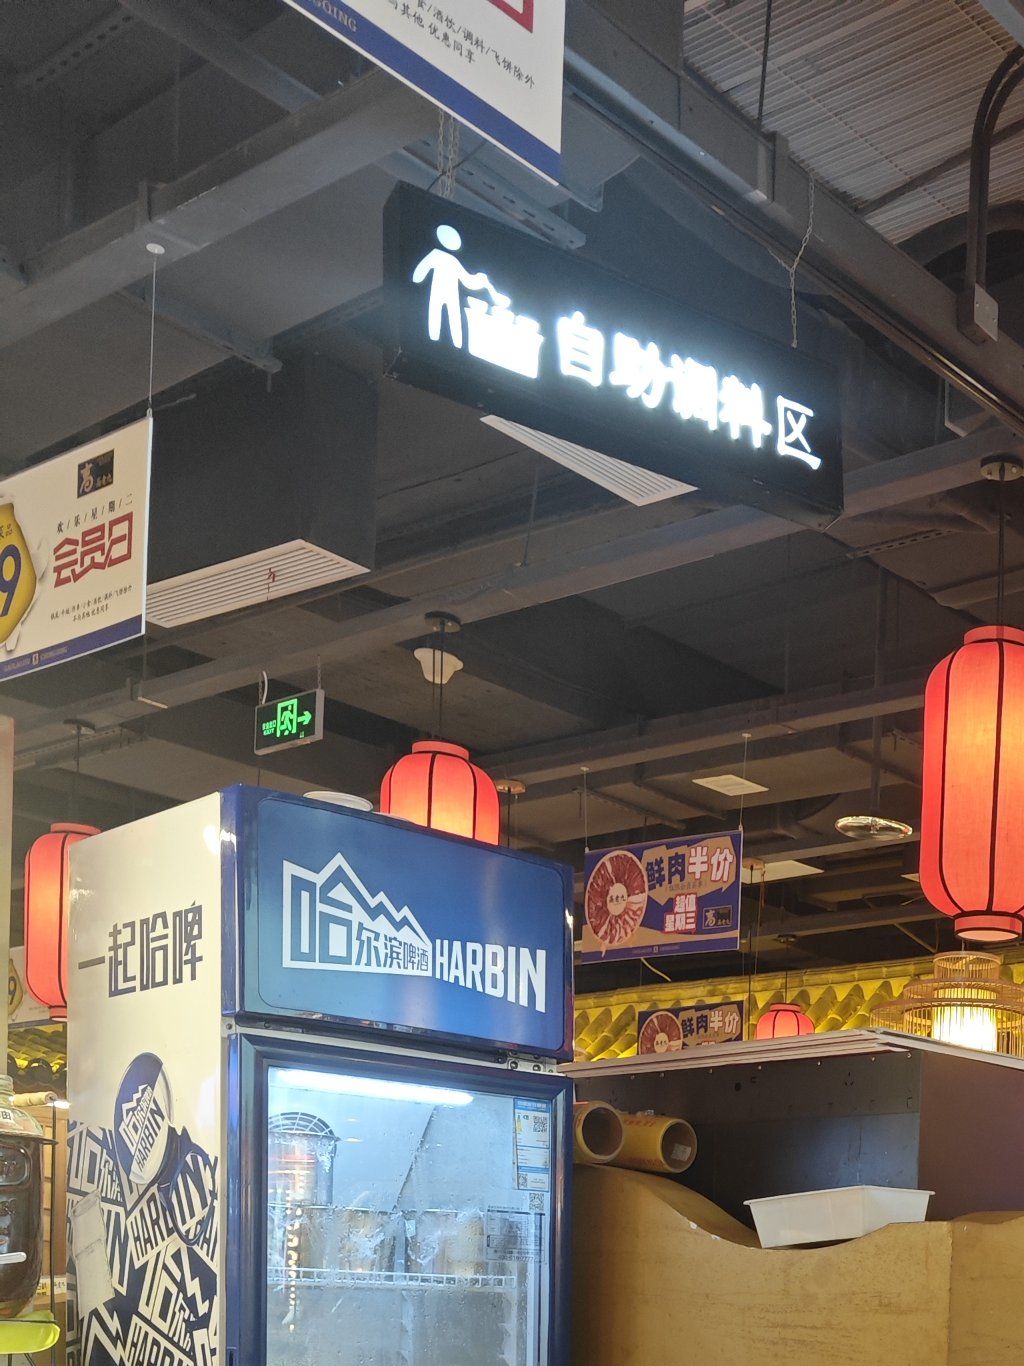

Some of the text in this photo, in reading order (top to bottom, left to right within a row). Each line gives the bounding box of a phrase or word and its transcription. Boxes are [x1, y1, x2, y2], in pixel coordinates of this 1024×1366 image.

[556, 310, 823, 471] 自助调料区
[53, 511, 134, 589] 会员日
[646, 846, 735, 891] 鲜肉半价
[673, 892, 698, 913] 超值
[78, 900, 204, 998] 一起哈啤
[290, 862, 430, 973] 哈尔滨啤酒
[664, 912, 697, 933] 星期三
[435, 938, 547, 1014] HARBIN
[135, 1097, 166, 1173] HARBIN
